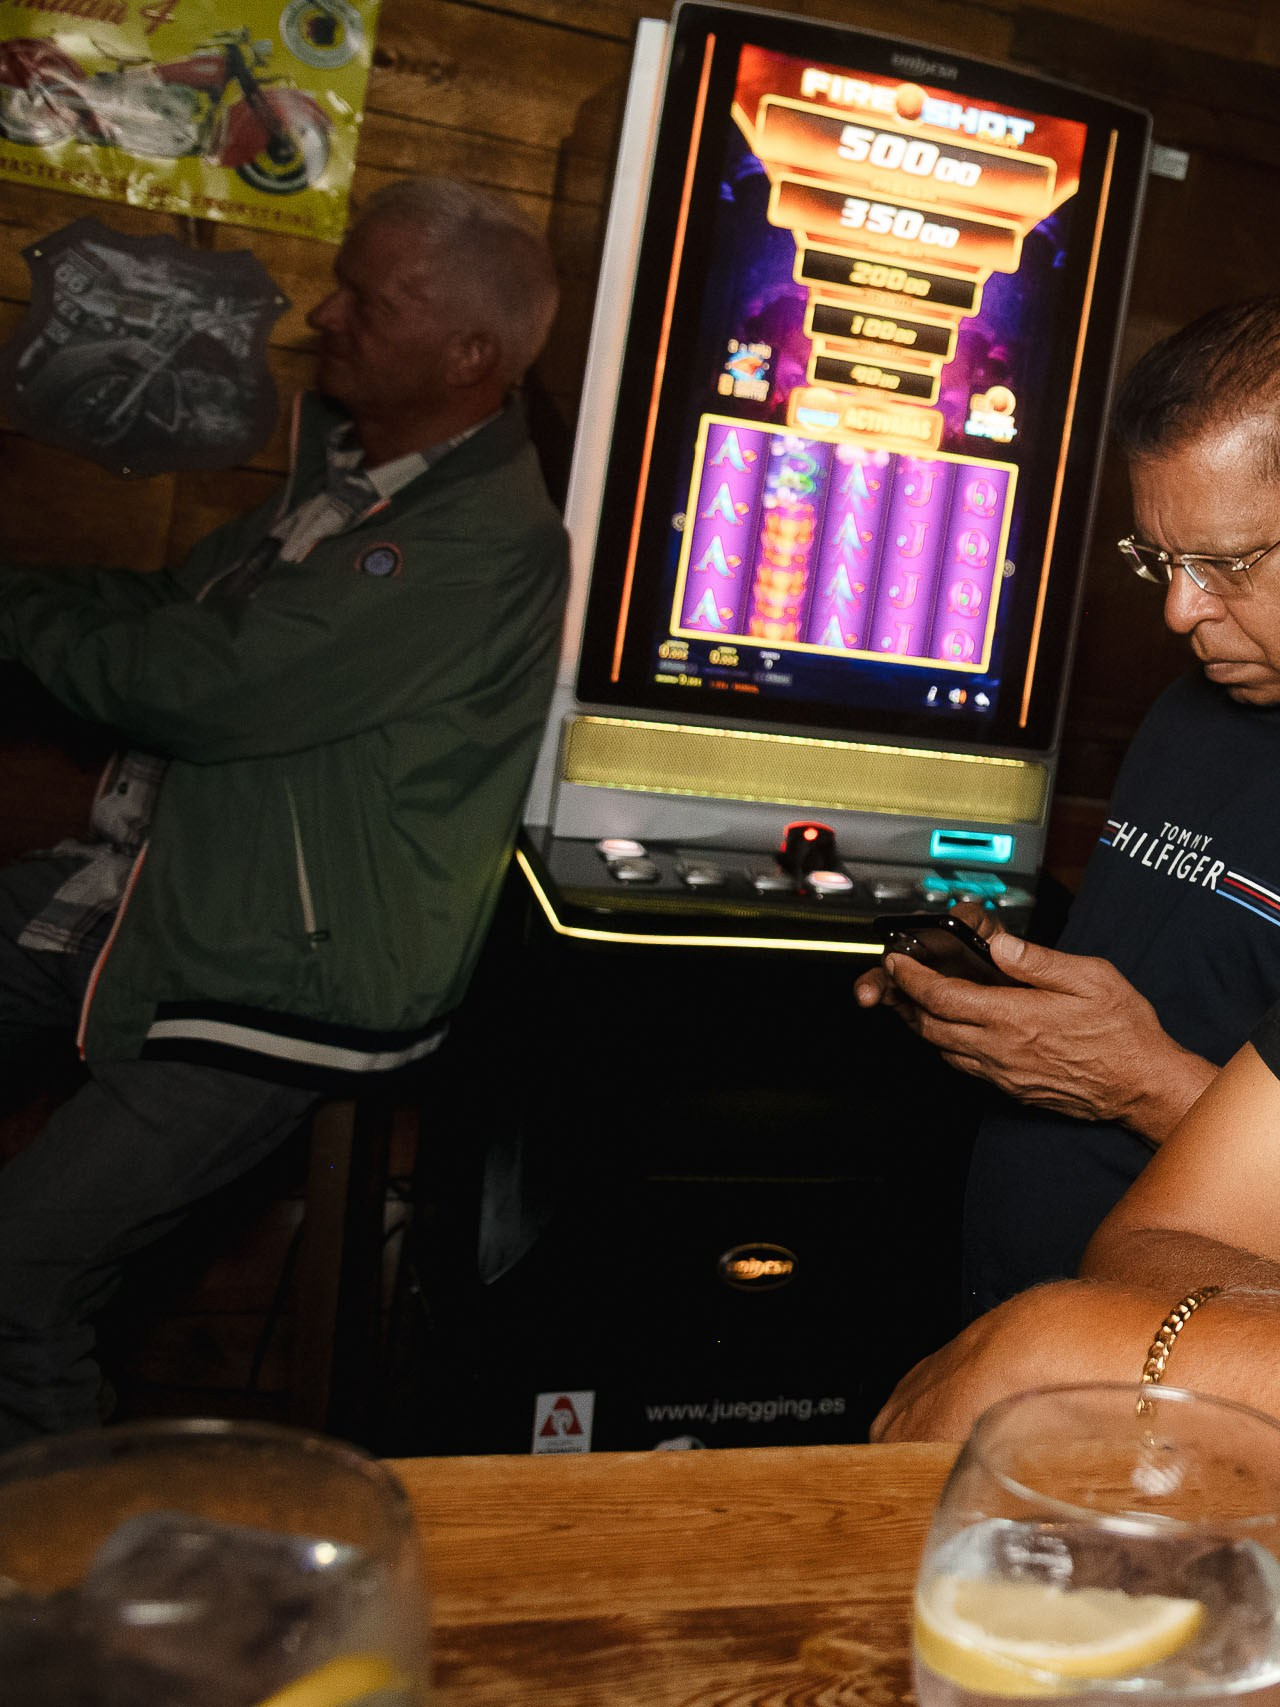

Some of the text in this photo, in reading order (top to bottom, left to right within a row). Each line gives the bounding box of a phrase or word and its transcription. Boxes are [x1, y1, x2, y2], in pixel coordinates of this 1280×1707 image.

[800, 67, 899, 114] FIRE
[920, 97, 1036, 147] SHOT
[1111, 821, 1226, 891] HILFIGER
[1160, 821, 1213, 852] TOMMY
[645, 1394, 846, 1424] www.juegging.es
